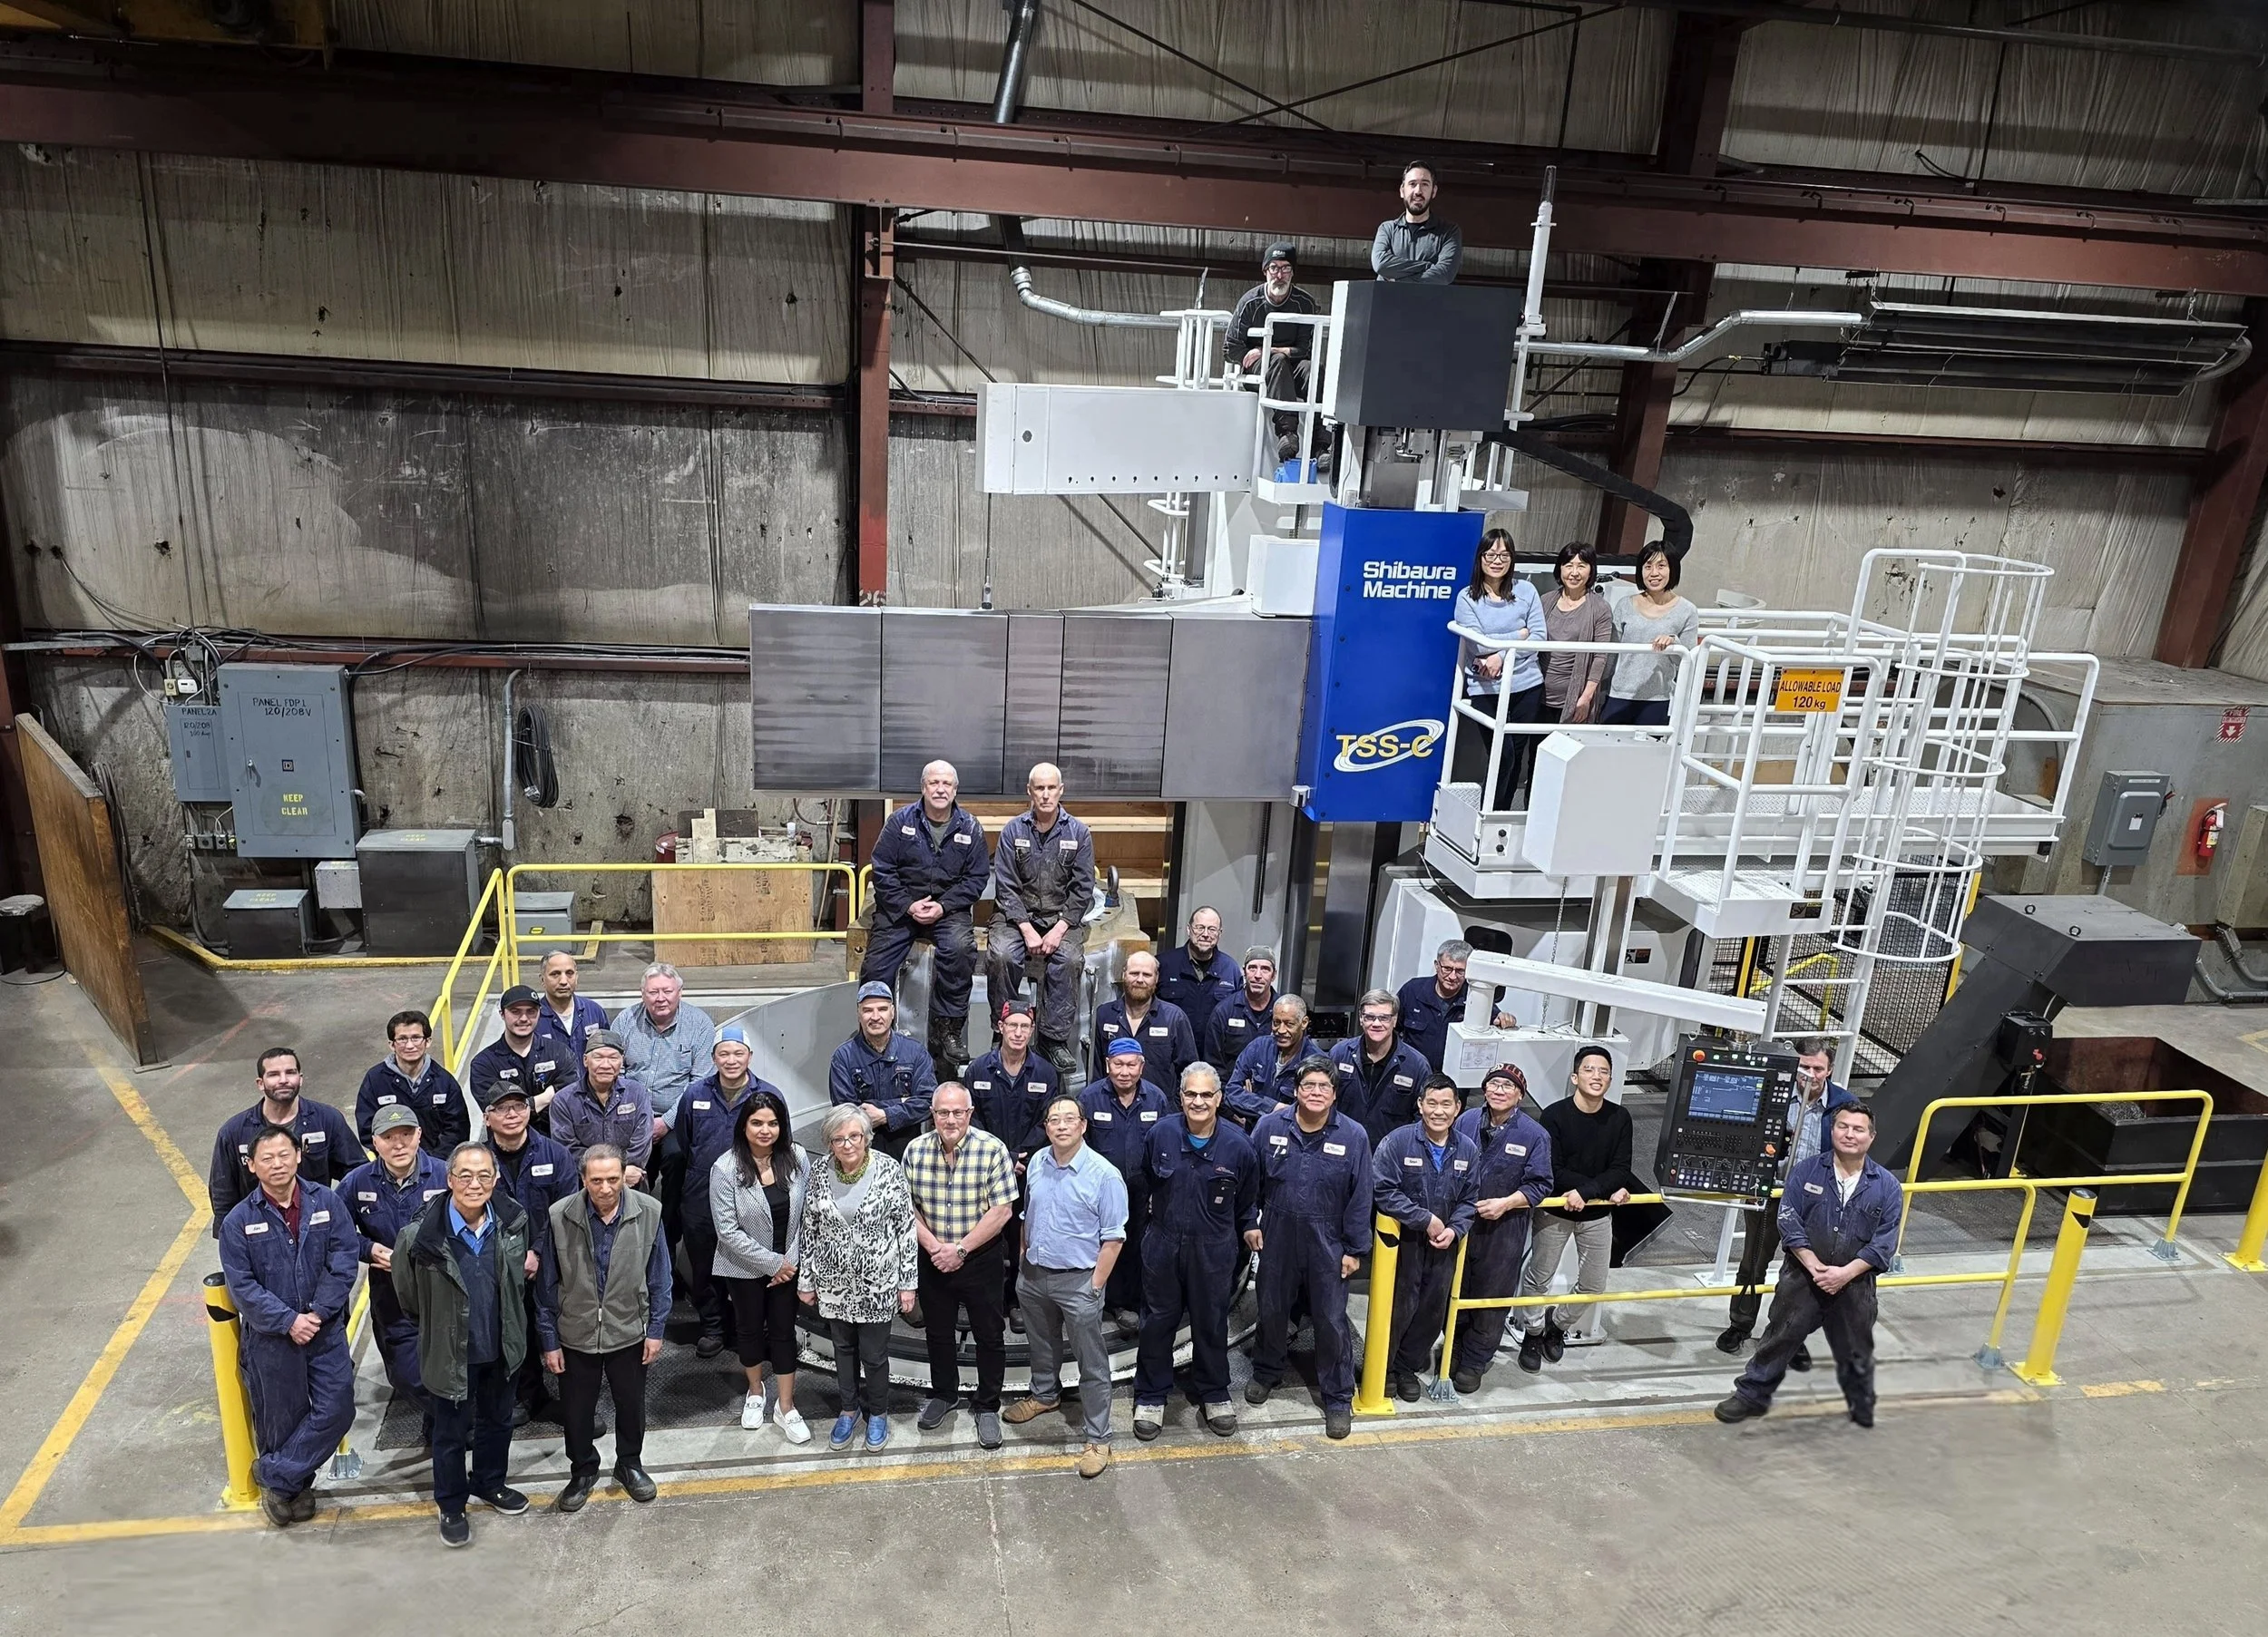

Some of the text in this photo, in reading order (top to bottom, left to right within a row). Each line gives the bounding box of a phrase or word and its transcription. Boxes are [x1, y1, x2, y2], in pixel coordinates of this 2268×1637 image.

[1363, 560, 1457, 580] Shibaura
[1363, 580, 1452, 599] Machine
[1779, 680, 1842, 693] ALLOWABLE LOAD
[252, 697, 282, 707] PANEL
[1794, 696, 1826, 710] 120 kg
[265, 706, 312, 717] 120/208V
[1335, 735, 1433, 758] TSS-C
[282, 793, 304, 803] KEEP
[281, 806, 308, 815] CLEAR
